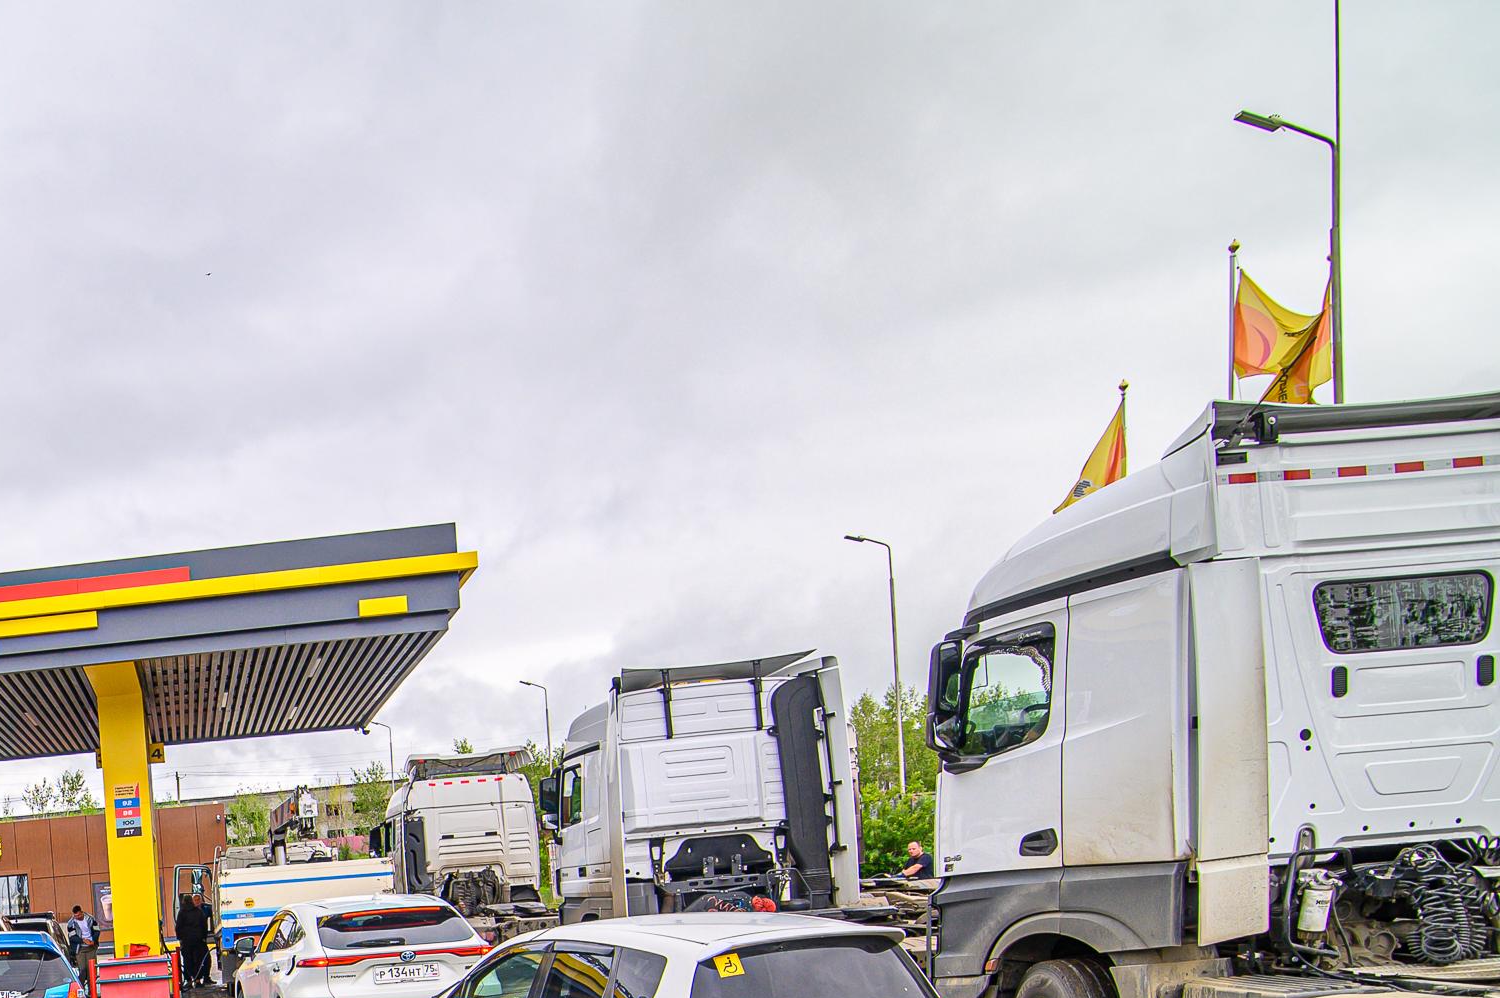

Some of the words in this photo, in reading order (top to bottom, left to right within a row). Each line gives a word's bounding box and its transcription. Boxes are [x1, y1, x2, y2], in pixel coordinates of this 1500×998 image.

[151, 748, 163, 759] 4
[379, 967, 421, 979] Р134НТ
[424, 965, 435, 973] 75
